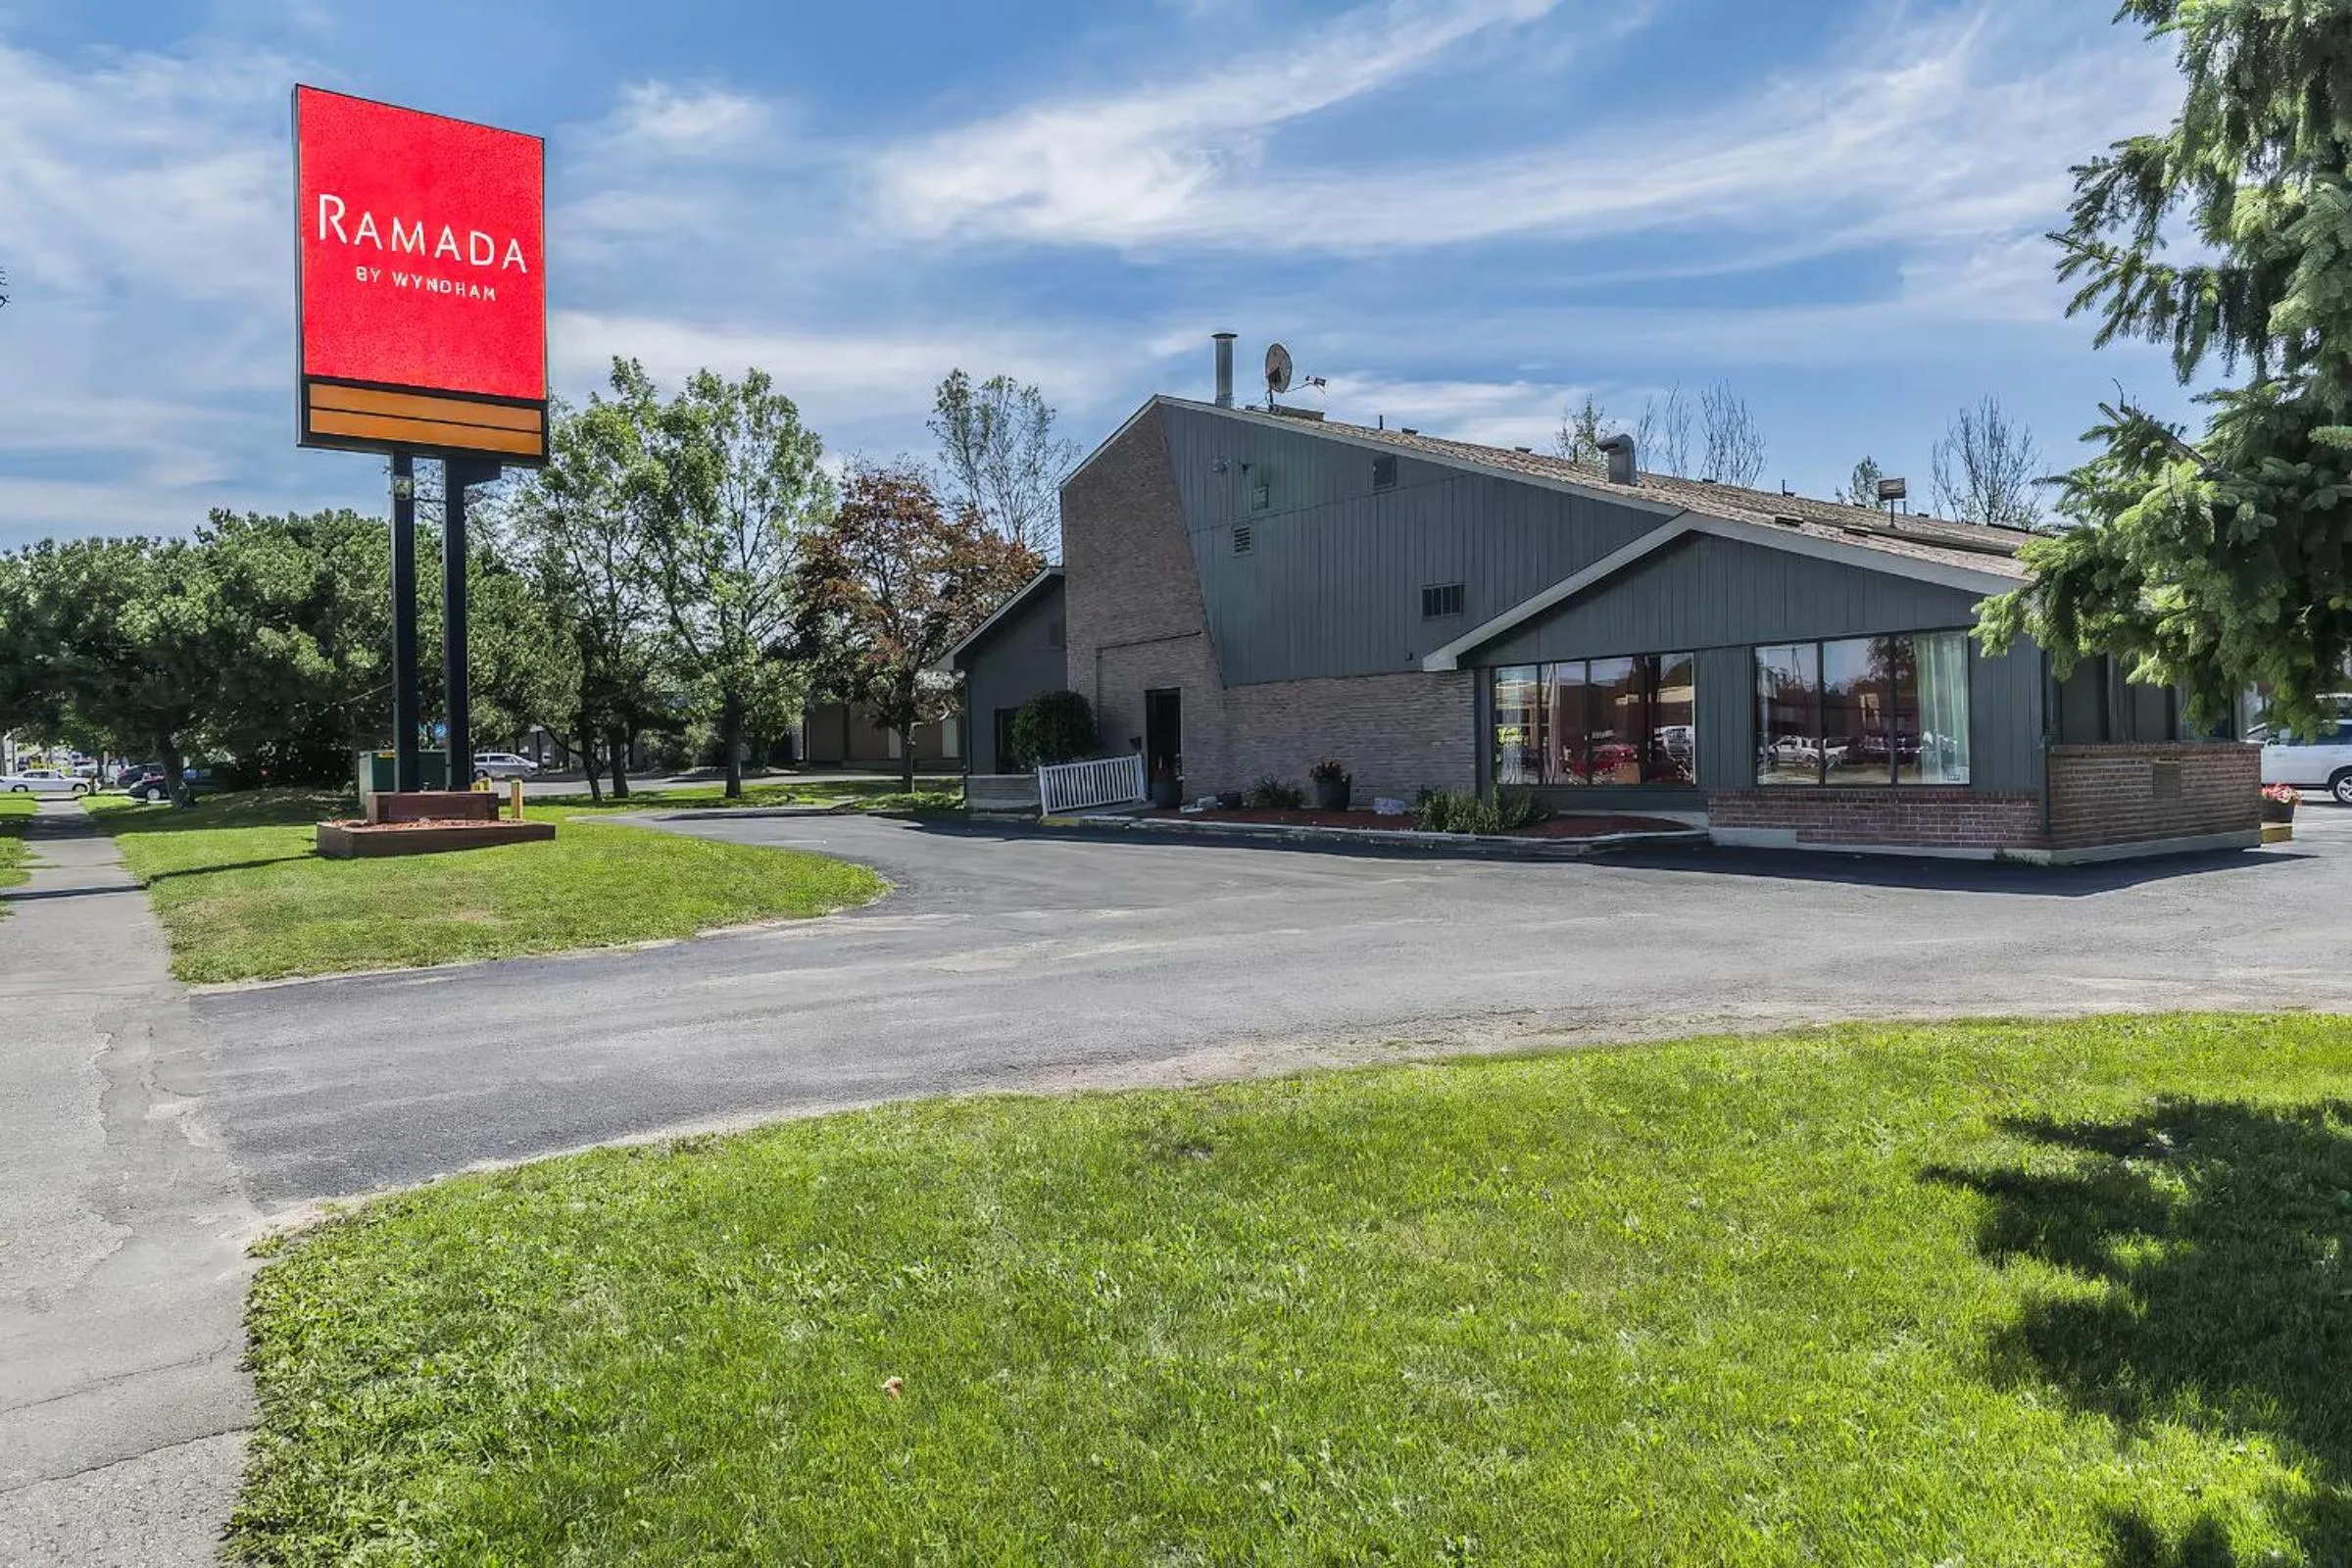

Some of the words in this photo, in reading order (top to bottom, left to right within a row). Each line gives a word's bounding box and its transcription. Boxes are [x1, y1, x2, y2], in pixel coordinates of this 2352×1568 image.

[318, 193, 527, 273] RAMADA
[356, 266, 381, 282] BY
[392, 271, 497, 301] WYNDHAM
